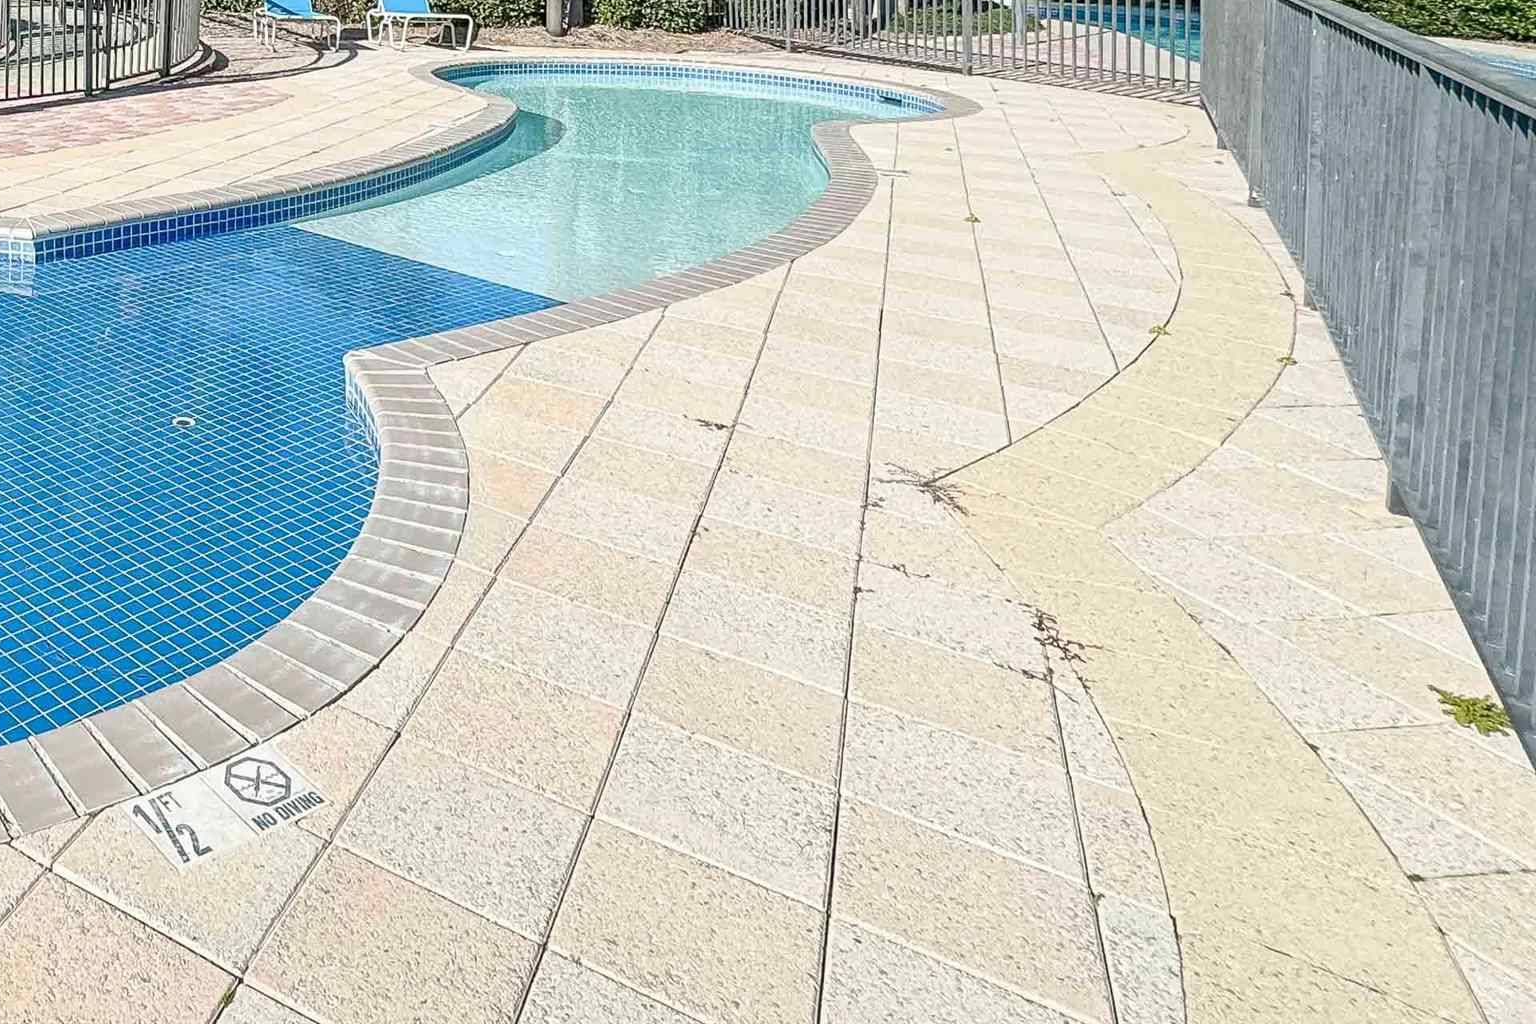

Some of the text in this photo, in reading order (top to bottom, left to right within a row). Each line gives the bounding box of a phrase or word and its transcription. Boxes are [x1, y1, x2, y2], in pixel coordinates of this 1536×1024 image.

[156, 791, 182, 812] FT
[251, 791, 325, 831] NO DIVING
